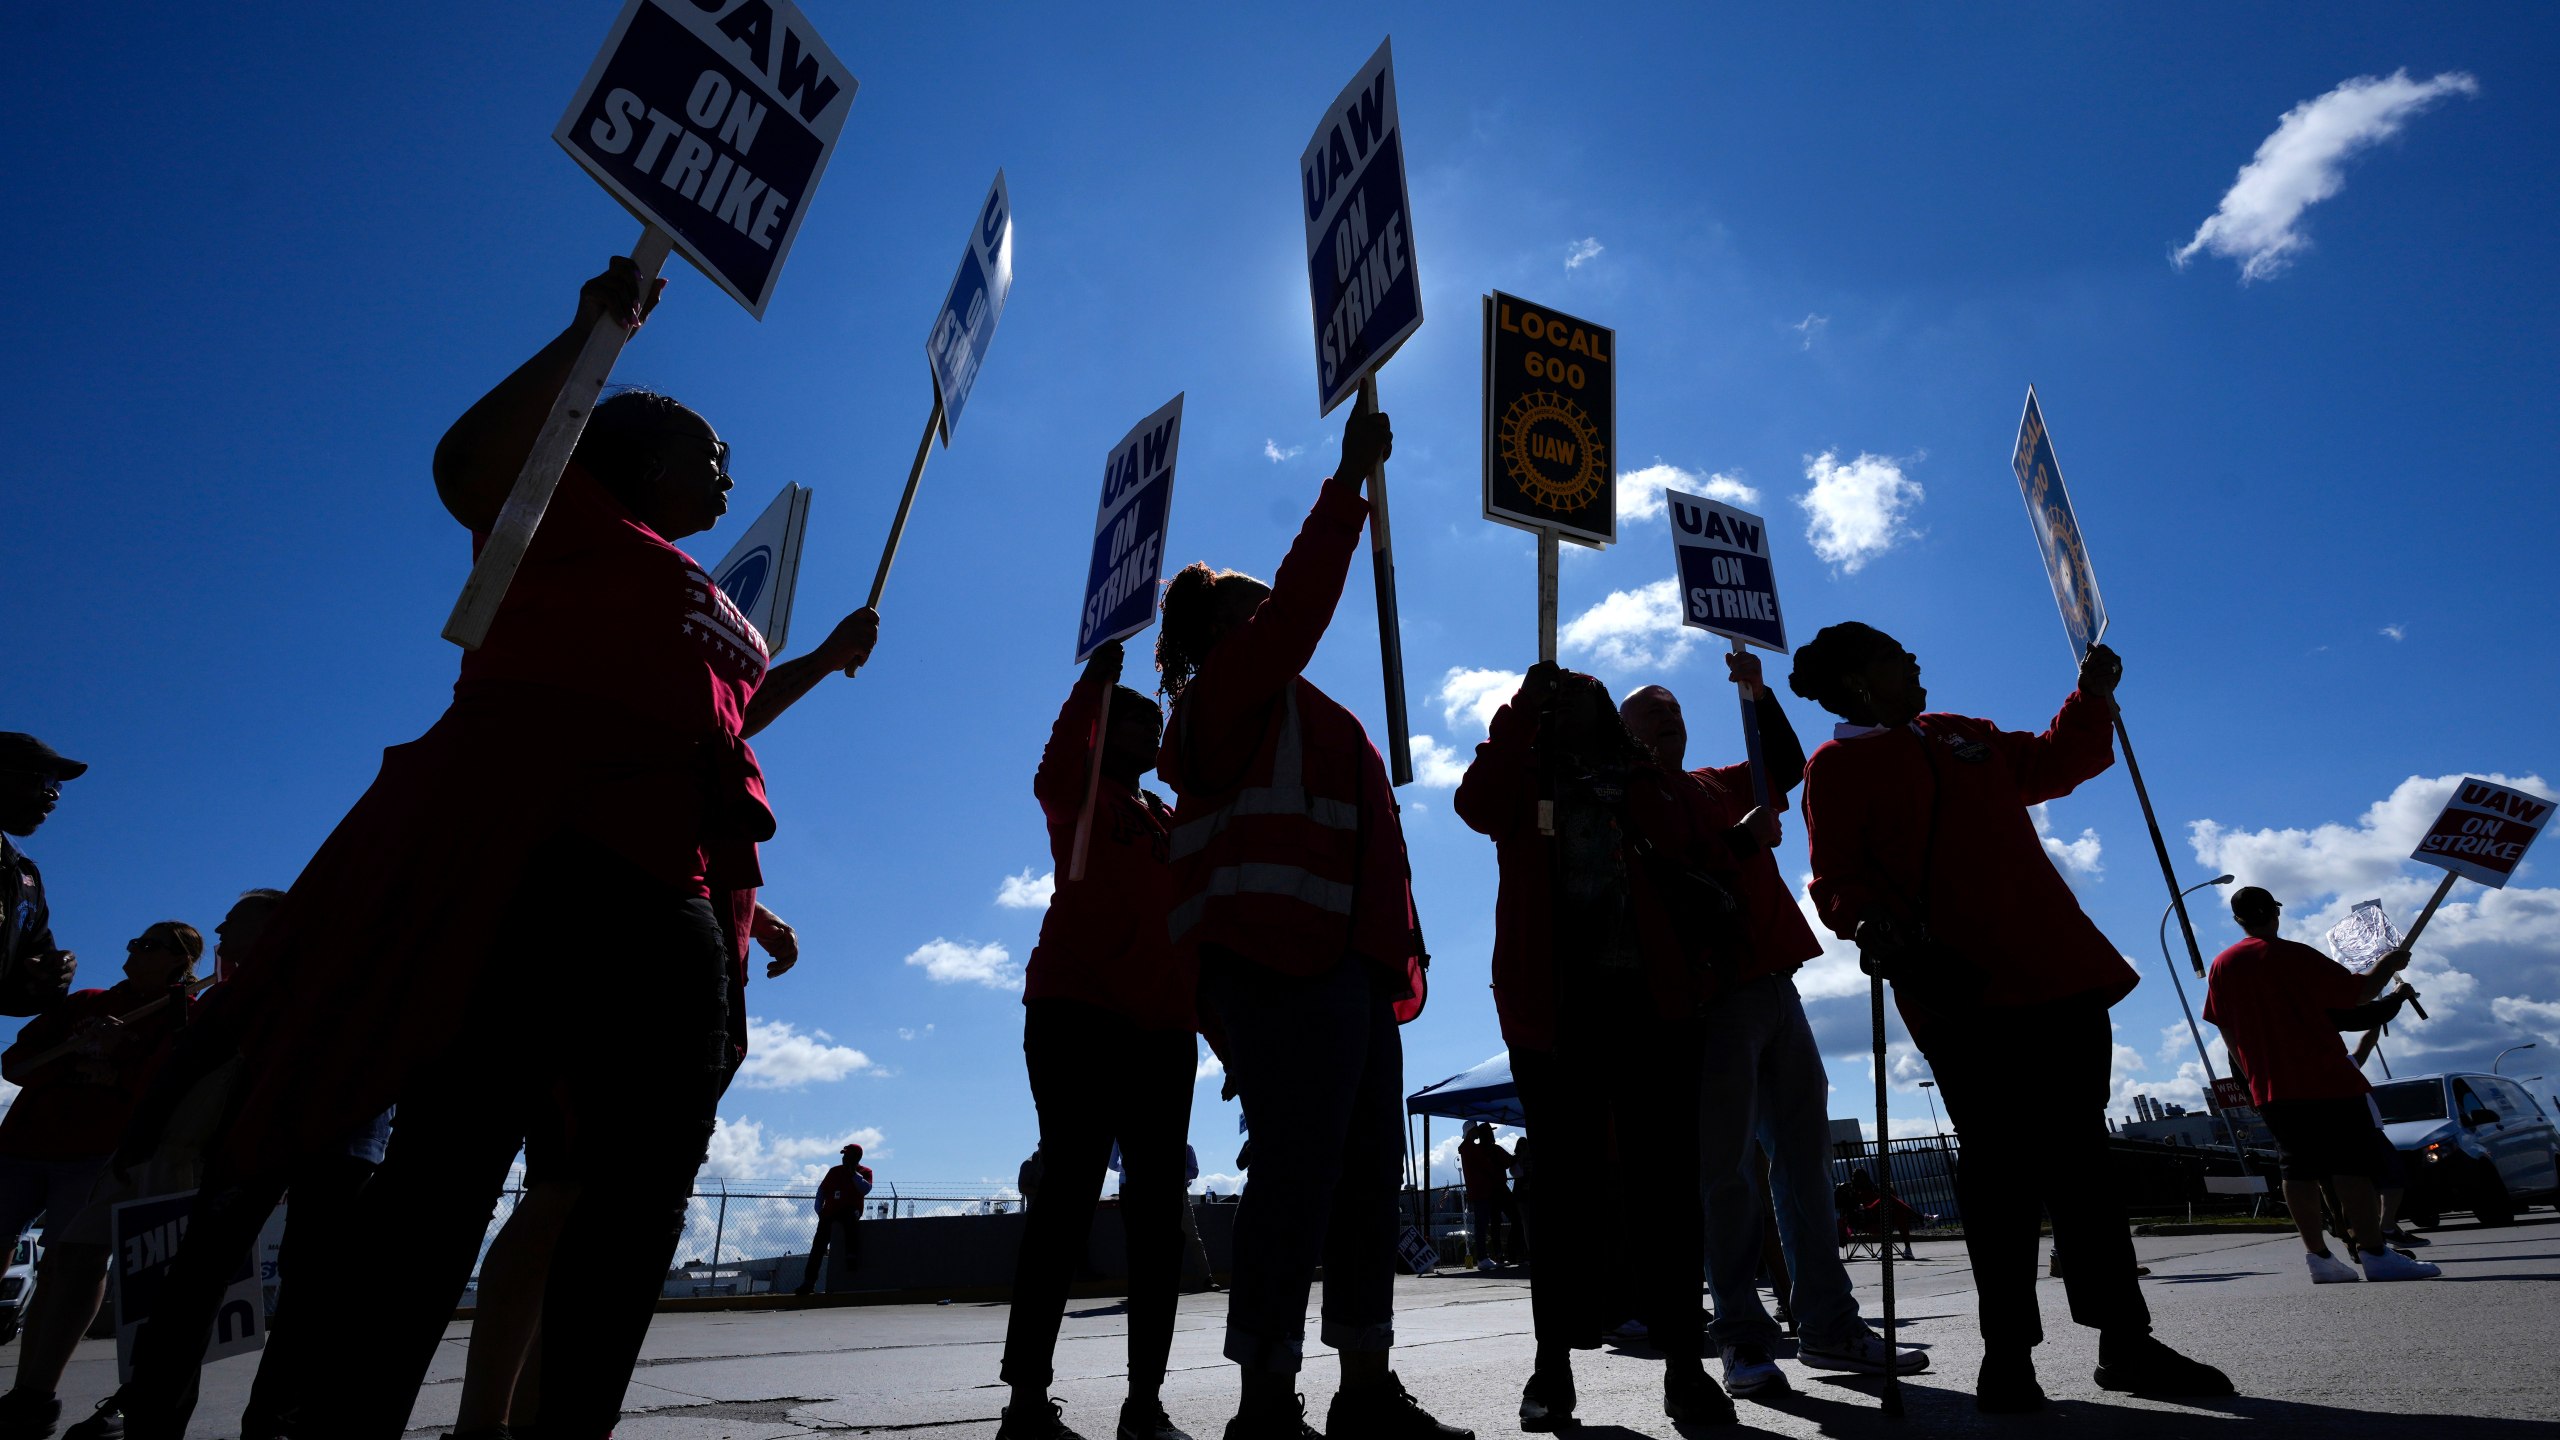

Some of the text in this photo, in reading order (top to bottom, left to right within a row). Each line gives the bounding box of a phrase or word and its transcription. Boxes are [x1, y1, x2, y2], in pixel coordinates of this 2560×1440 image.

[686, 69, 768, 156] ON
[590, 87, 789, 250] STRIKE
[1306, 67, 1385, 222] UAW
[1335, 186, 1369, 284] ON
[965, 287, 988, 343] ON
[1322, 209, 1405, 389] STRIKE
[937, 308, 978, 402] STRIKE
[1500, 303, 1608, 363] LOCAL
[1524, 351, 1586, 390] 600
[1103, 416, 1175, 508] UAW
[1531, 433, 1576, 466] UAW
[2016, 410, 2043, 494] LOCAL
[1109, 500, 1141, 568] ON
[1674, 502, 1760, 553] UAW
[1083, 529, 1158, 645] STRIKE
[1711, 556, 1746, 586] ON
[1690, 587, 1776, 622] STRIKE
[2461, 783, 2547, 824] UAW
[2461, 817, 2504, 838] ON
[2422, 834, 2526, 861] STRIKE
[2217, 1082, 2240, 1093] WRO
[2228, 1092, 2247, 1103] WA
